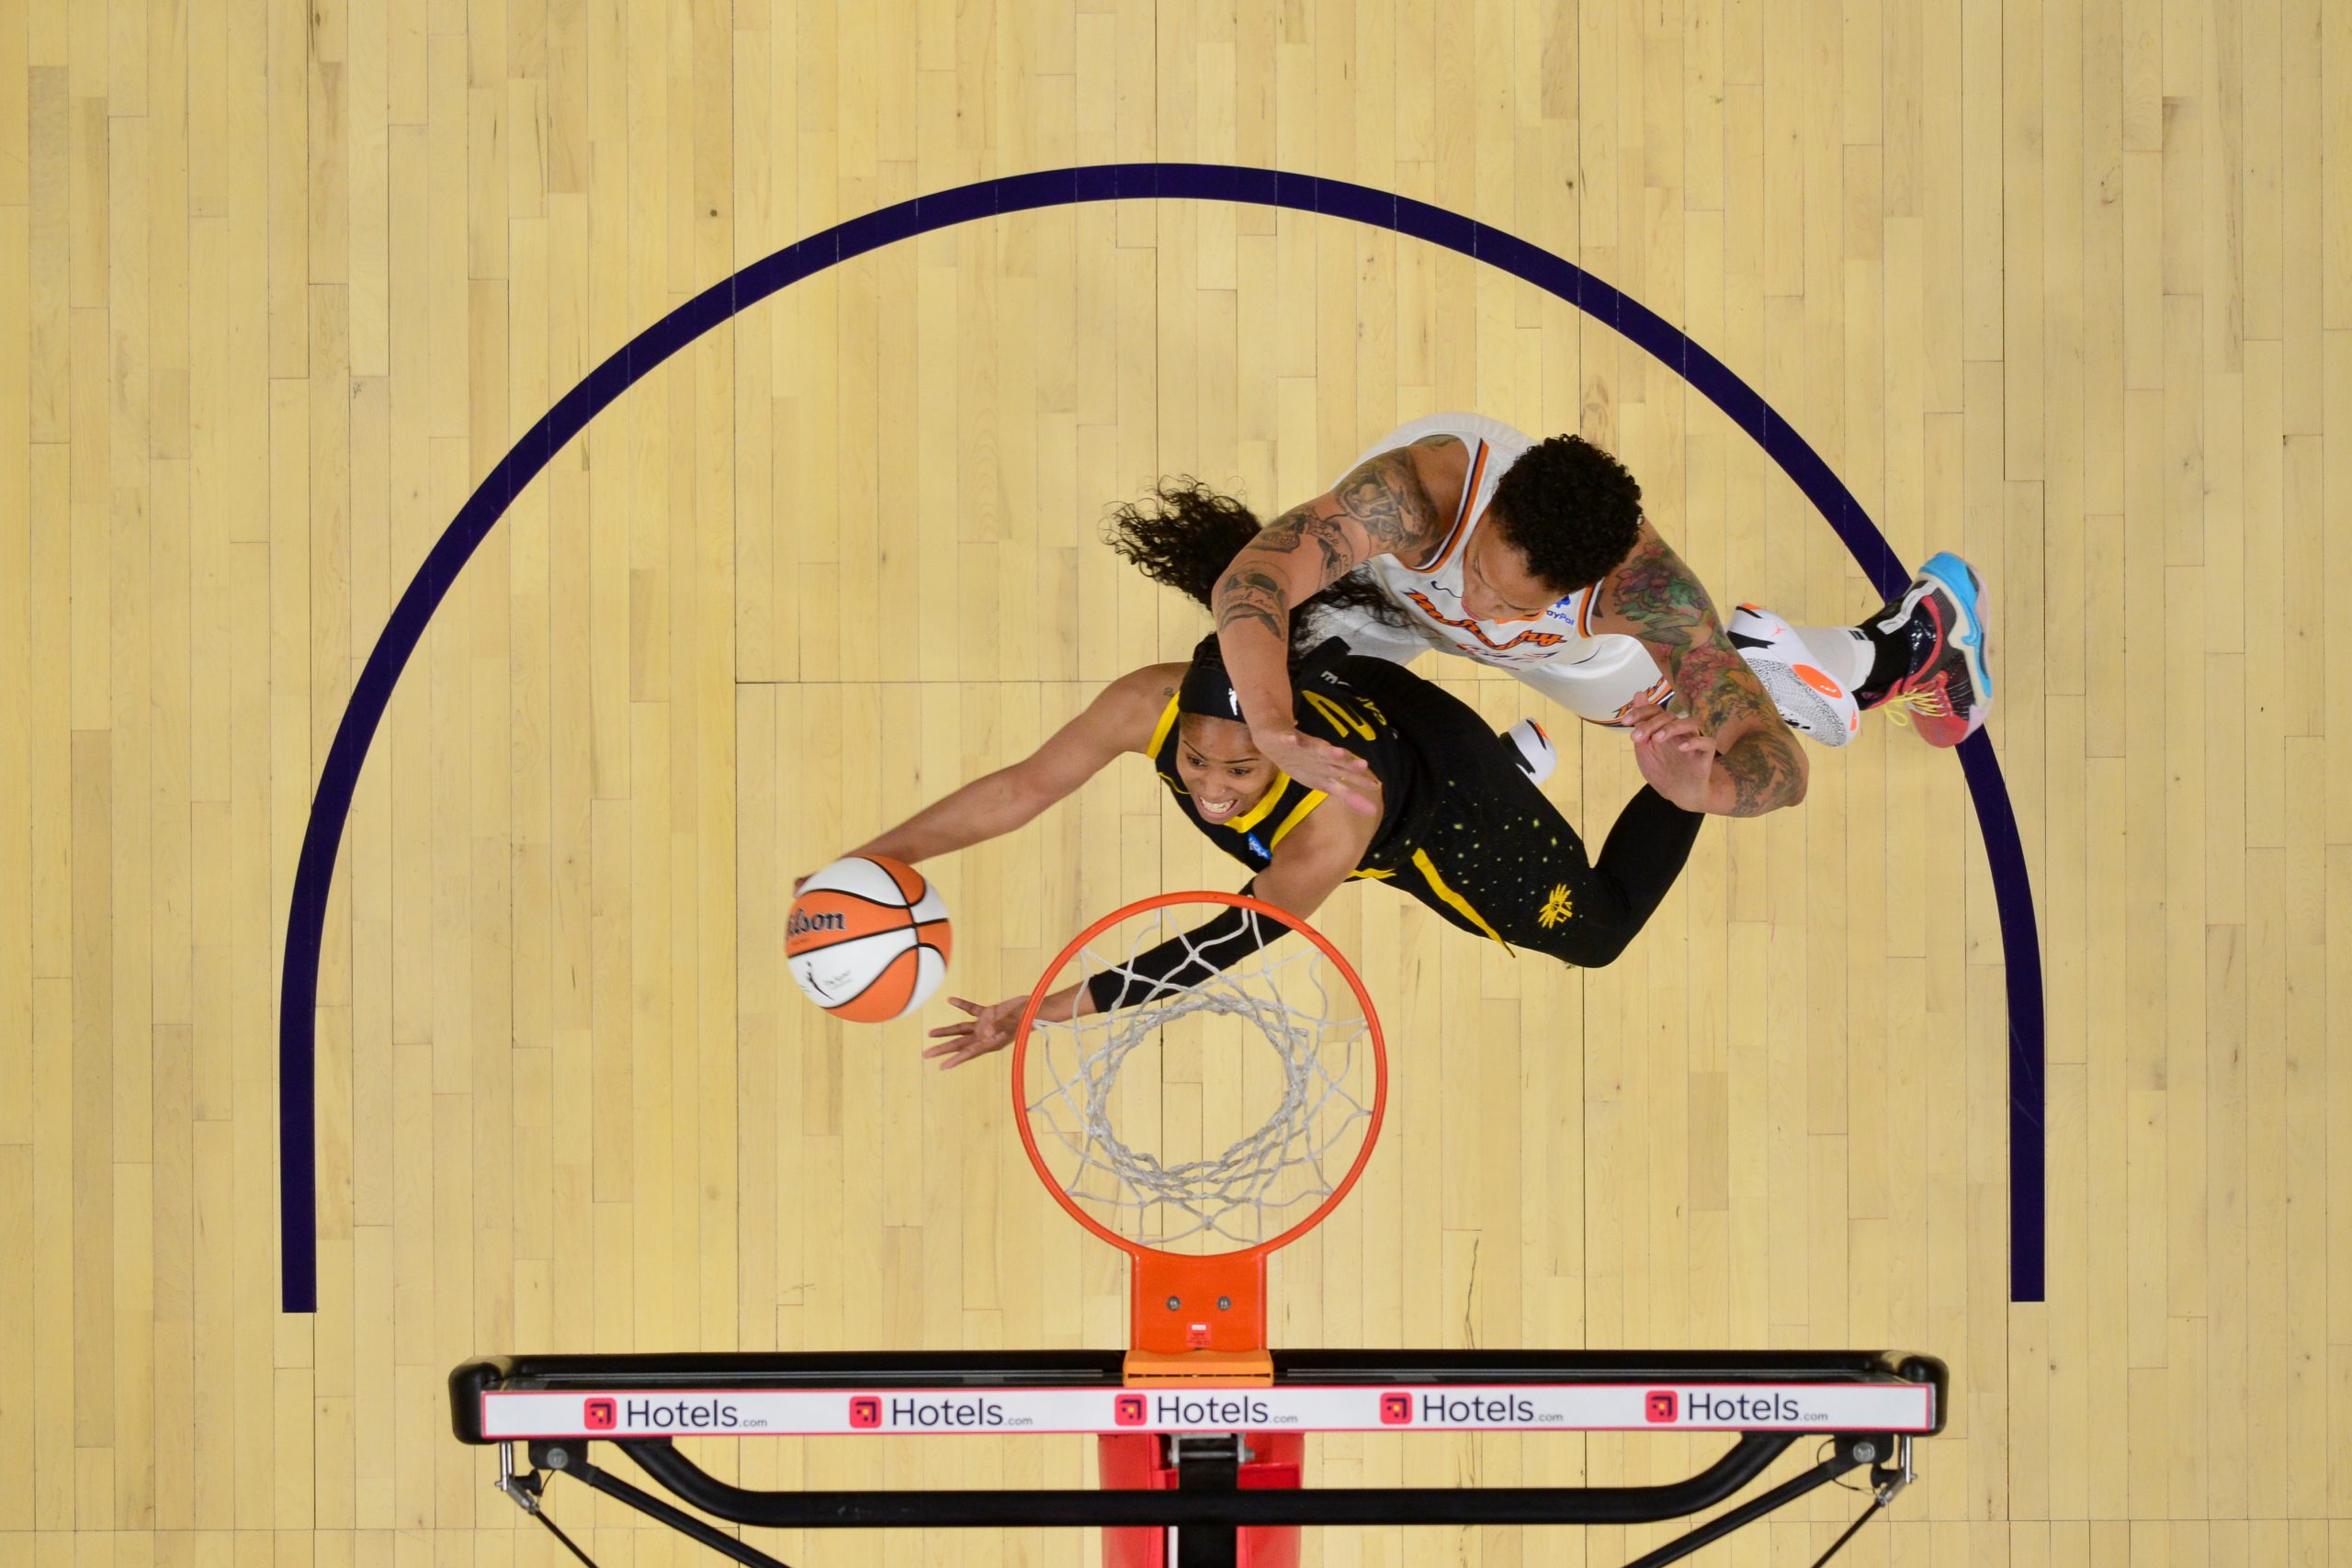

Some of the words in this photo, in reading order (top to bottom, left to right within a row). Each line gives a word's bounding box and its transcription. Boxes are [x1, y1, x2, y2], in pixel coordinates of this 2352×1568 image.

[1546, 610, 1575, 626] ayPal
[628, 1399, 768, 1428] Hotels.com
[892, 1397, 1034, 1427] Hotels.com
[1158, 1395, 1298, 1425] Hotels.com
[1423, 1393, 1565, 1423] Hotels.com
[1688, 1392, 1829, 1422] Hotels.com
